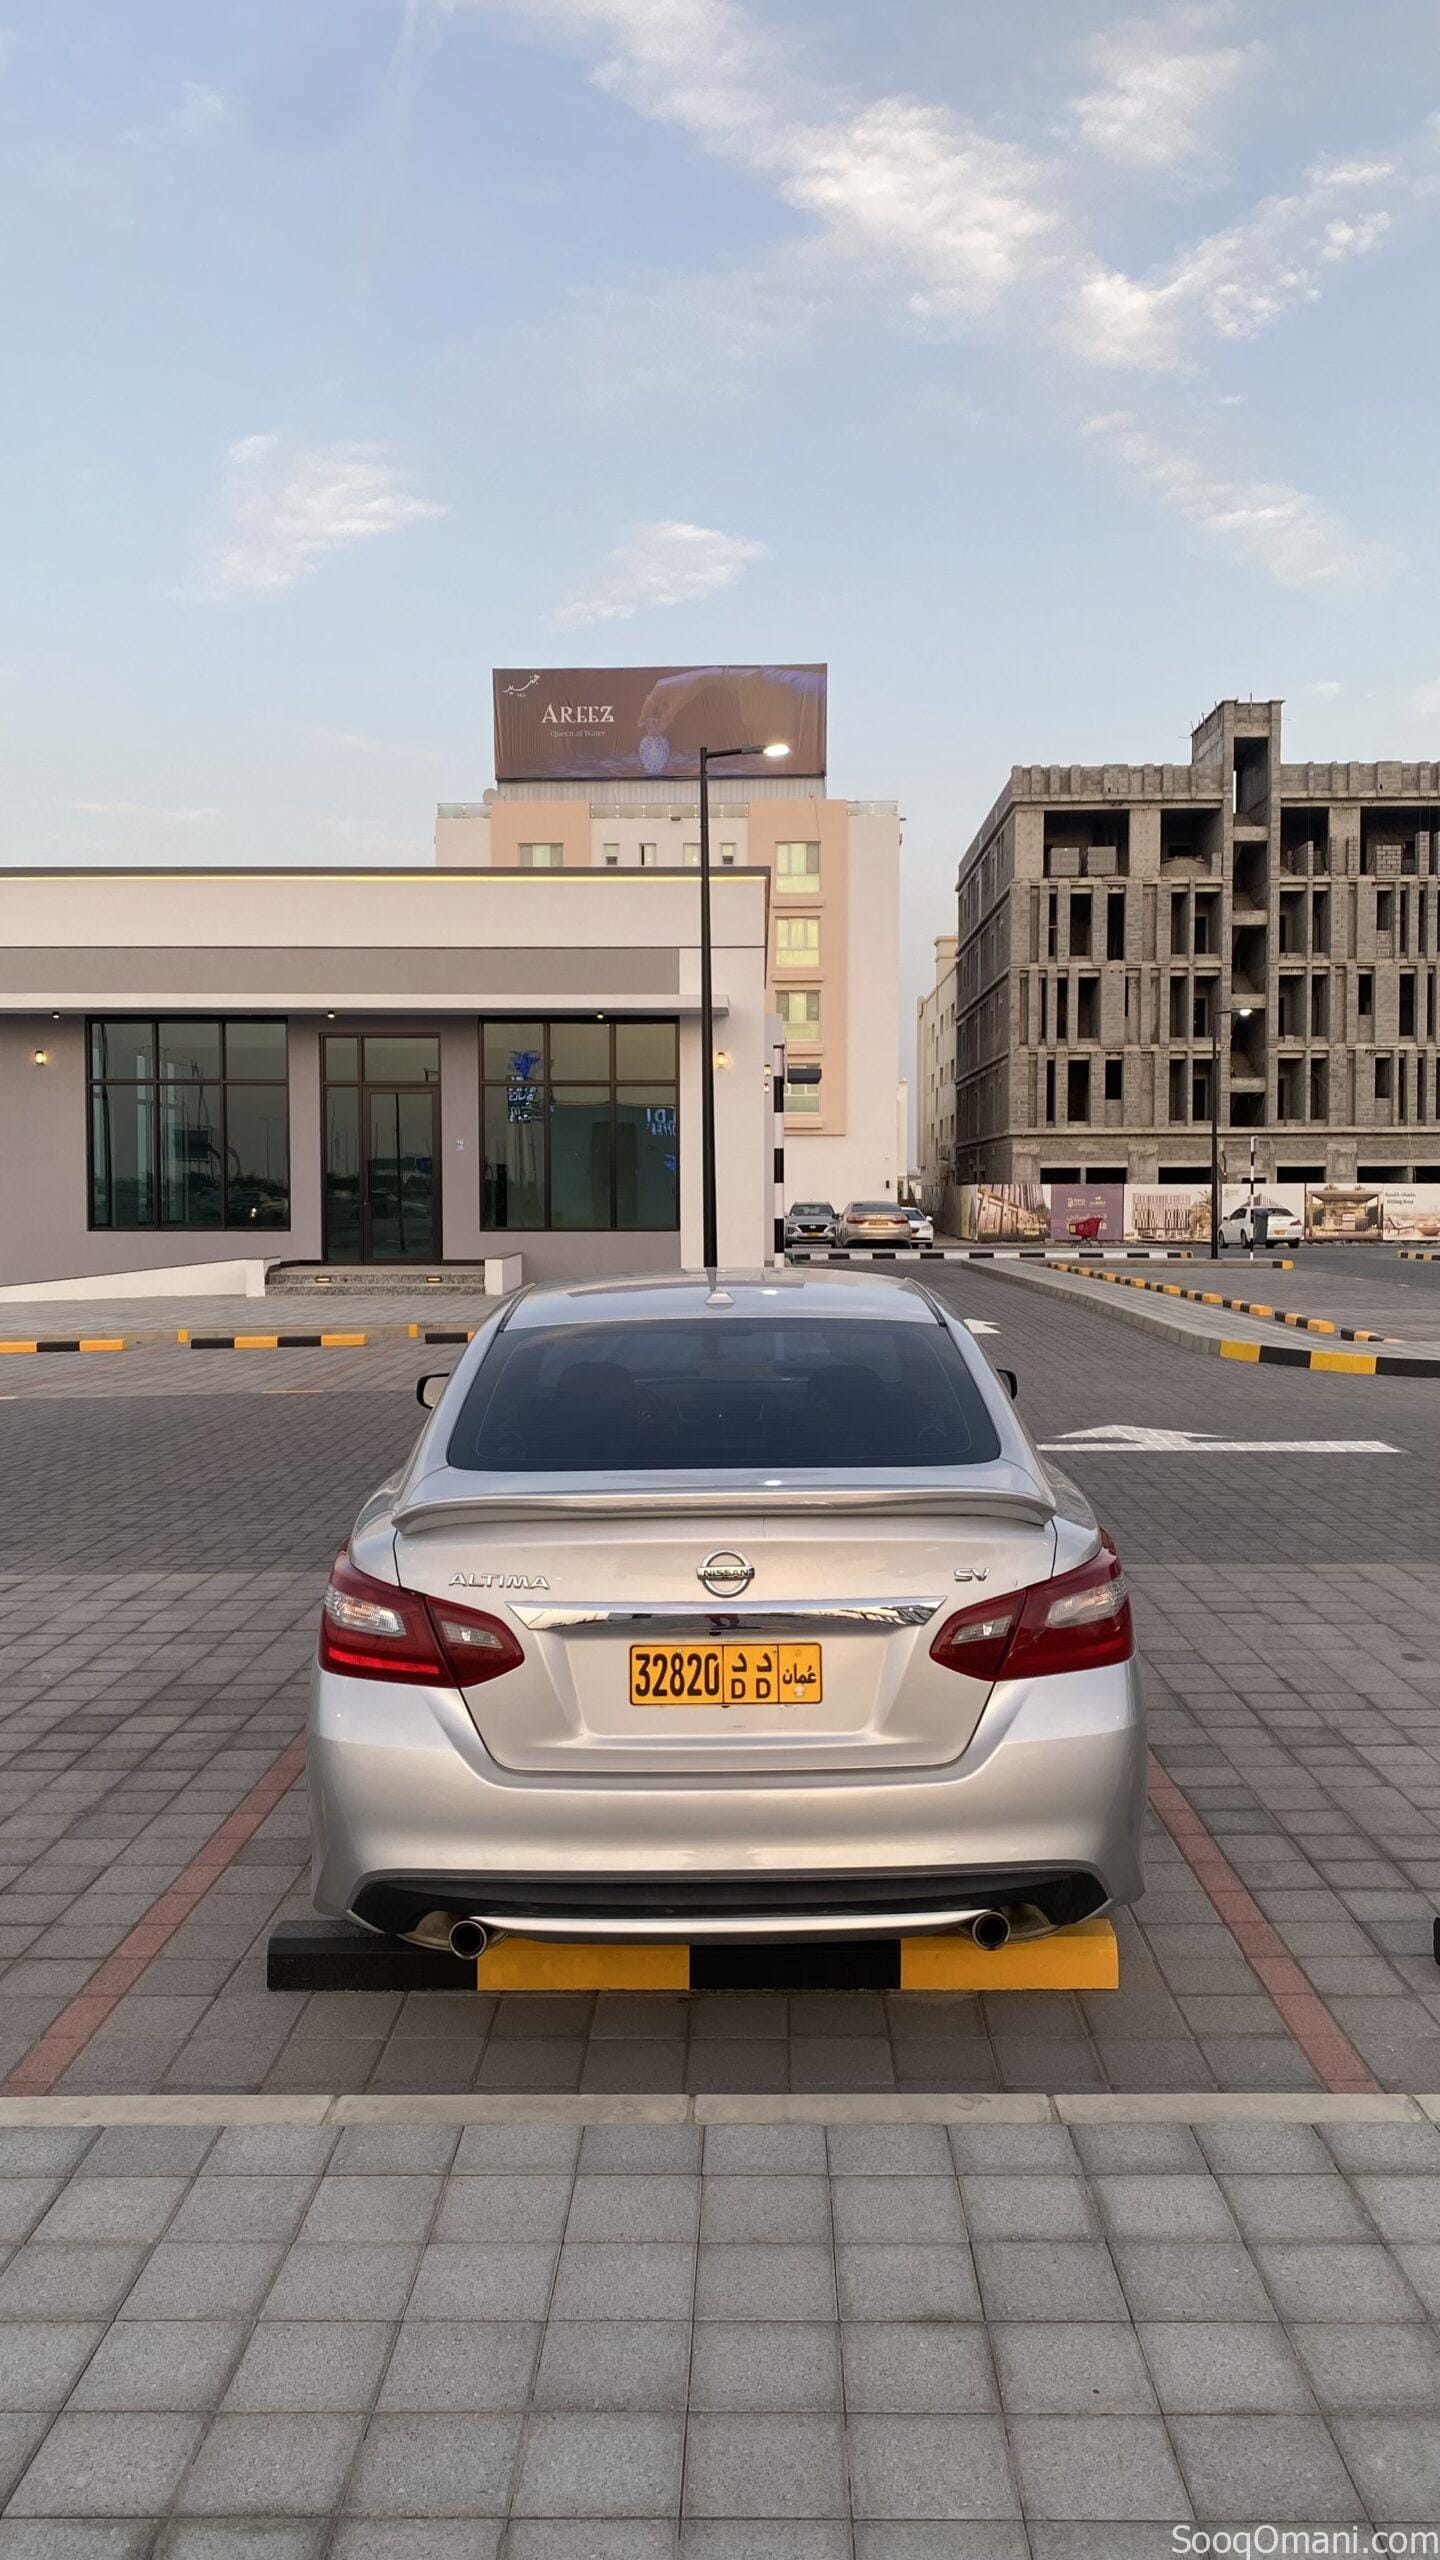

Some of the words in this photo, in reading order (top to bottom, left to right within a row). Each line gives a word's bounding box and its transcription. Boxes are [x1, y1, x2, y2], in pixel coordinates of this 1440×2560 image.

[541, 703, 616, 724] AREEZ
[550, 729, 574, 738] Queen
[584, 729, 606, 737] Water
[703, 1569, 749, 1577] NISSAN
[953, 1567, 990, 1582] SV
[448, 1573, 550, 1590] ALTIMA
[635, 1652, 720, 1697] 32820
